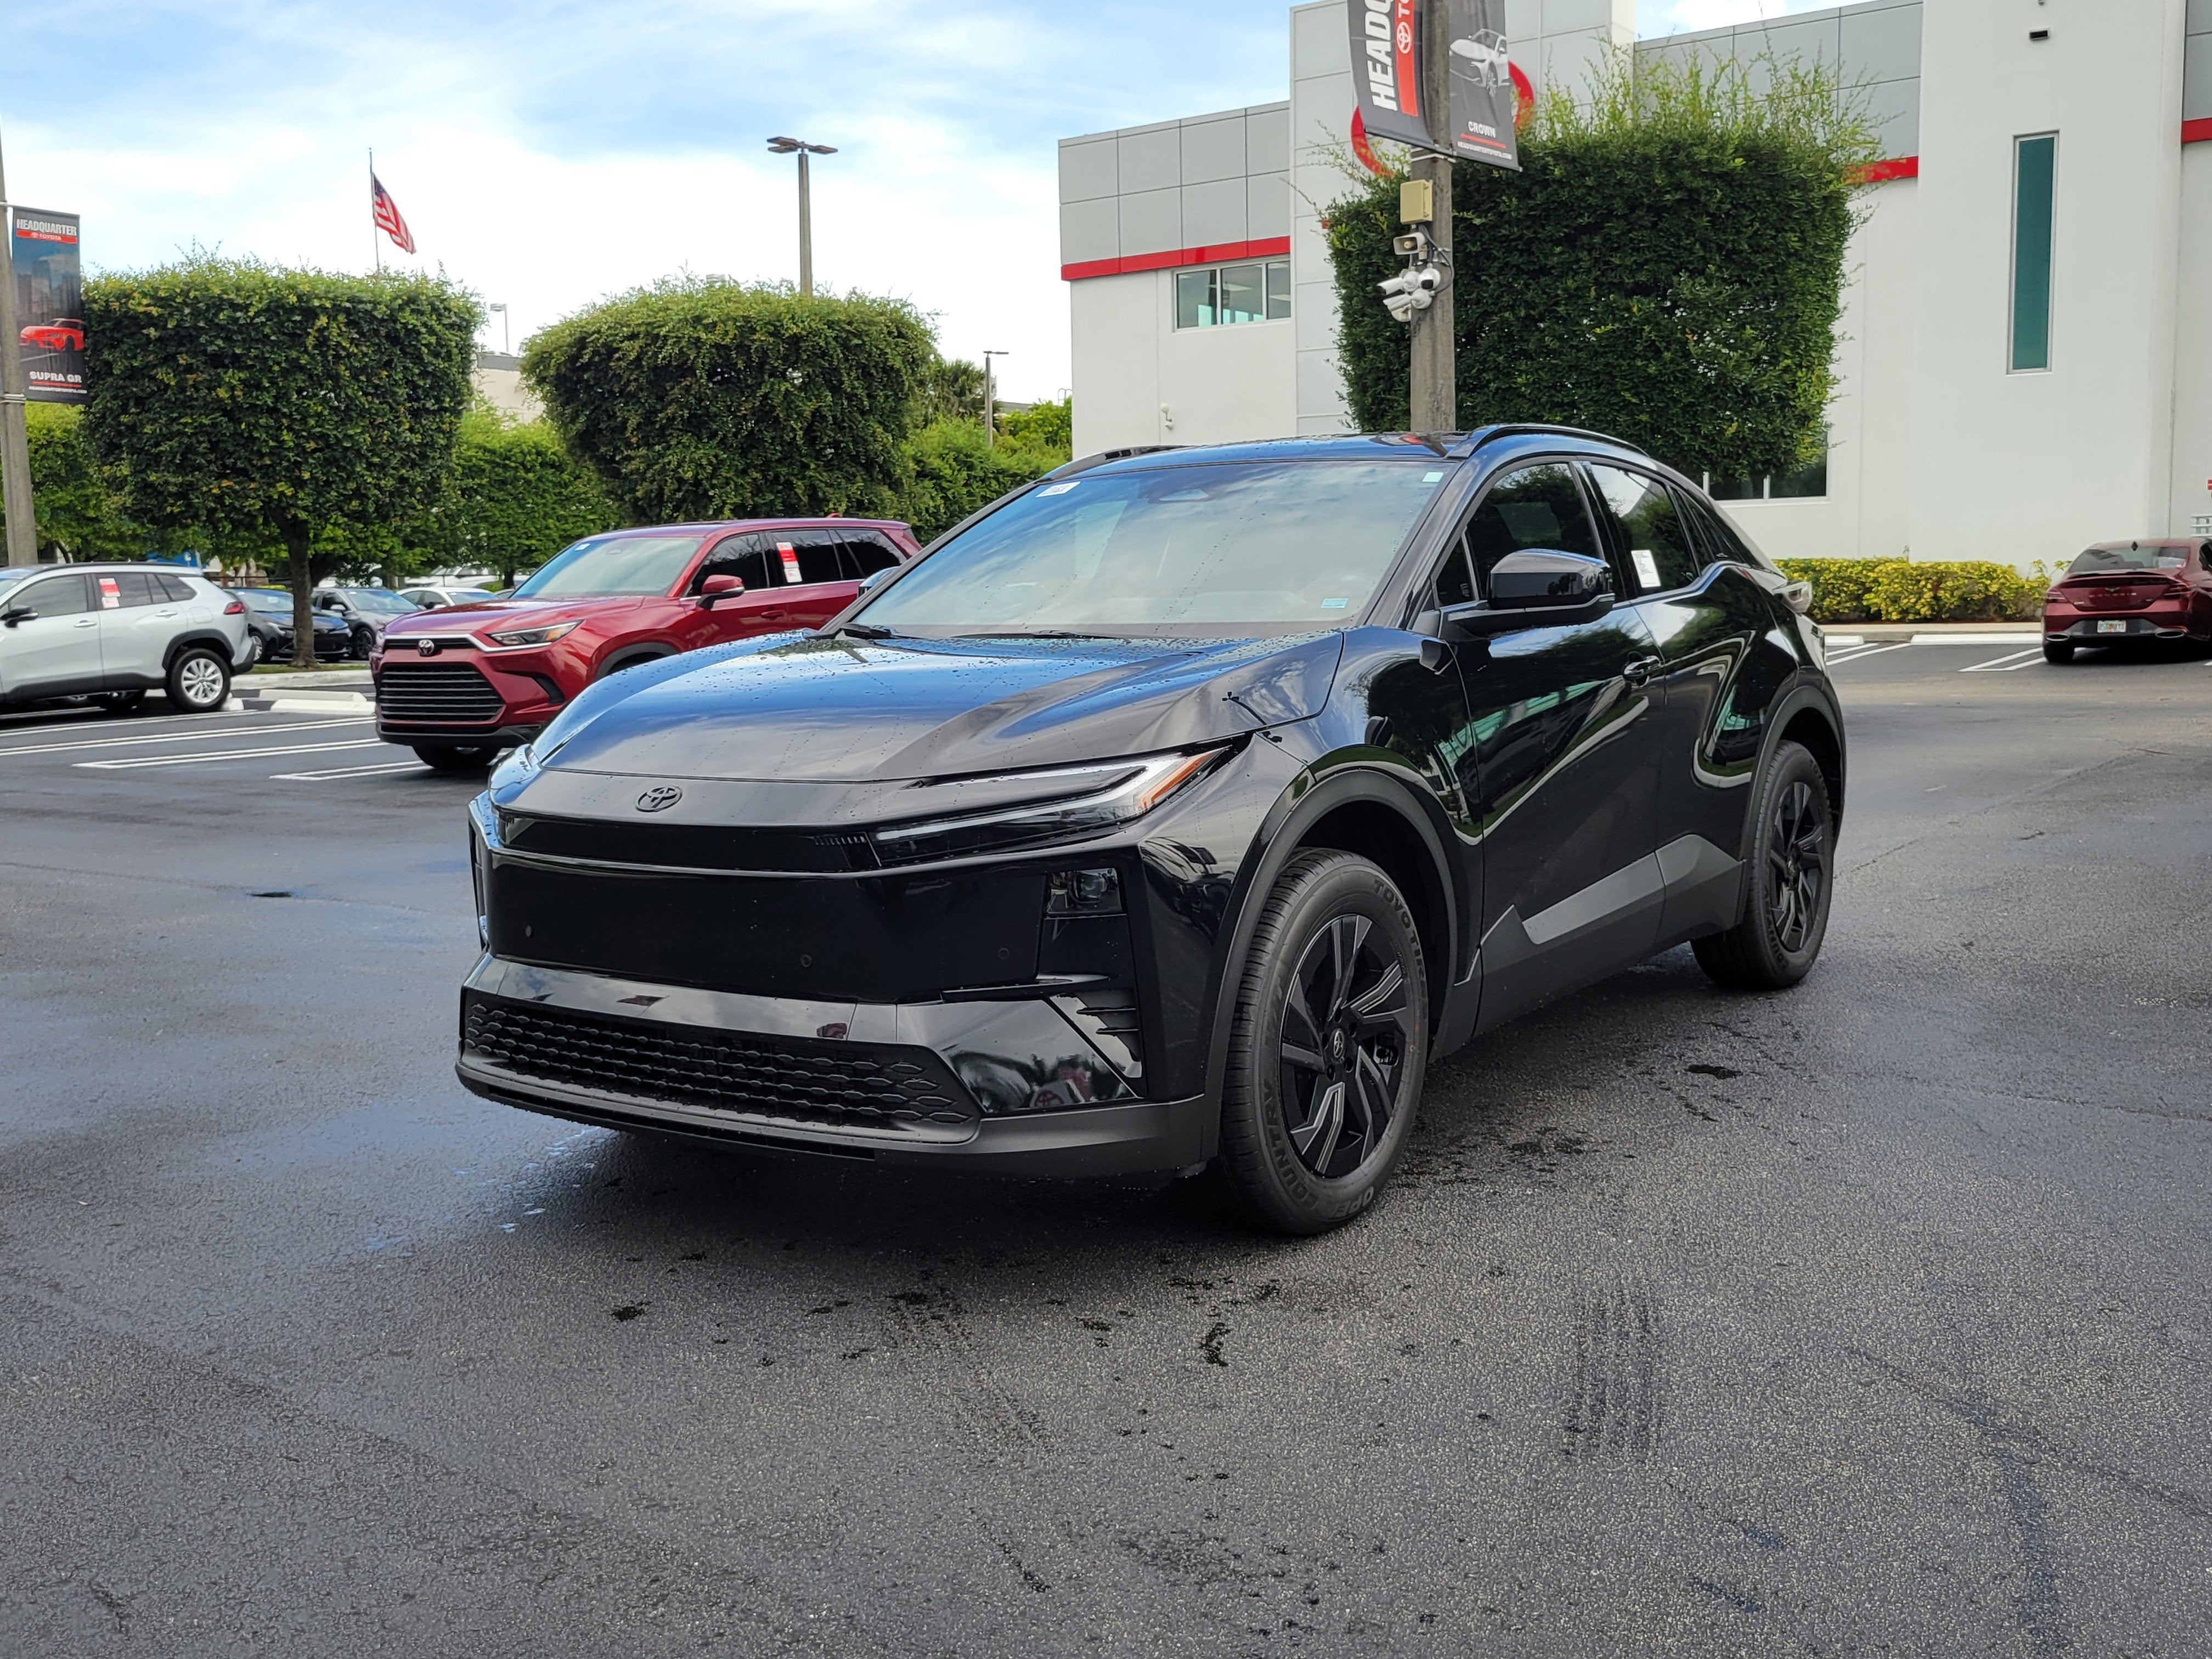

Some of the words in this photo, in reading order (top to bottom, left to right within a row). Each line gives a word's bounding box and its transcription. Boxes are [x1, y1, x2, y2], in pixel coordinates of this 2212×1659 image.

[1468, 121, 1497, 139] CROWN
[16, 218, 77, 236] HEADQUARTER
[39, 233, 62, 241] TOYOTA
[30, 371, 65, 382] SUPRA
[66, 374, 82, 383] GR
[1373, 878, 1411, 930] TOYO
